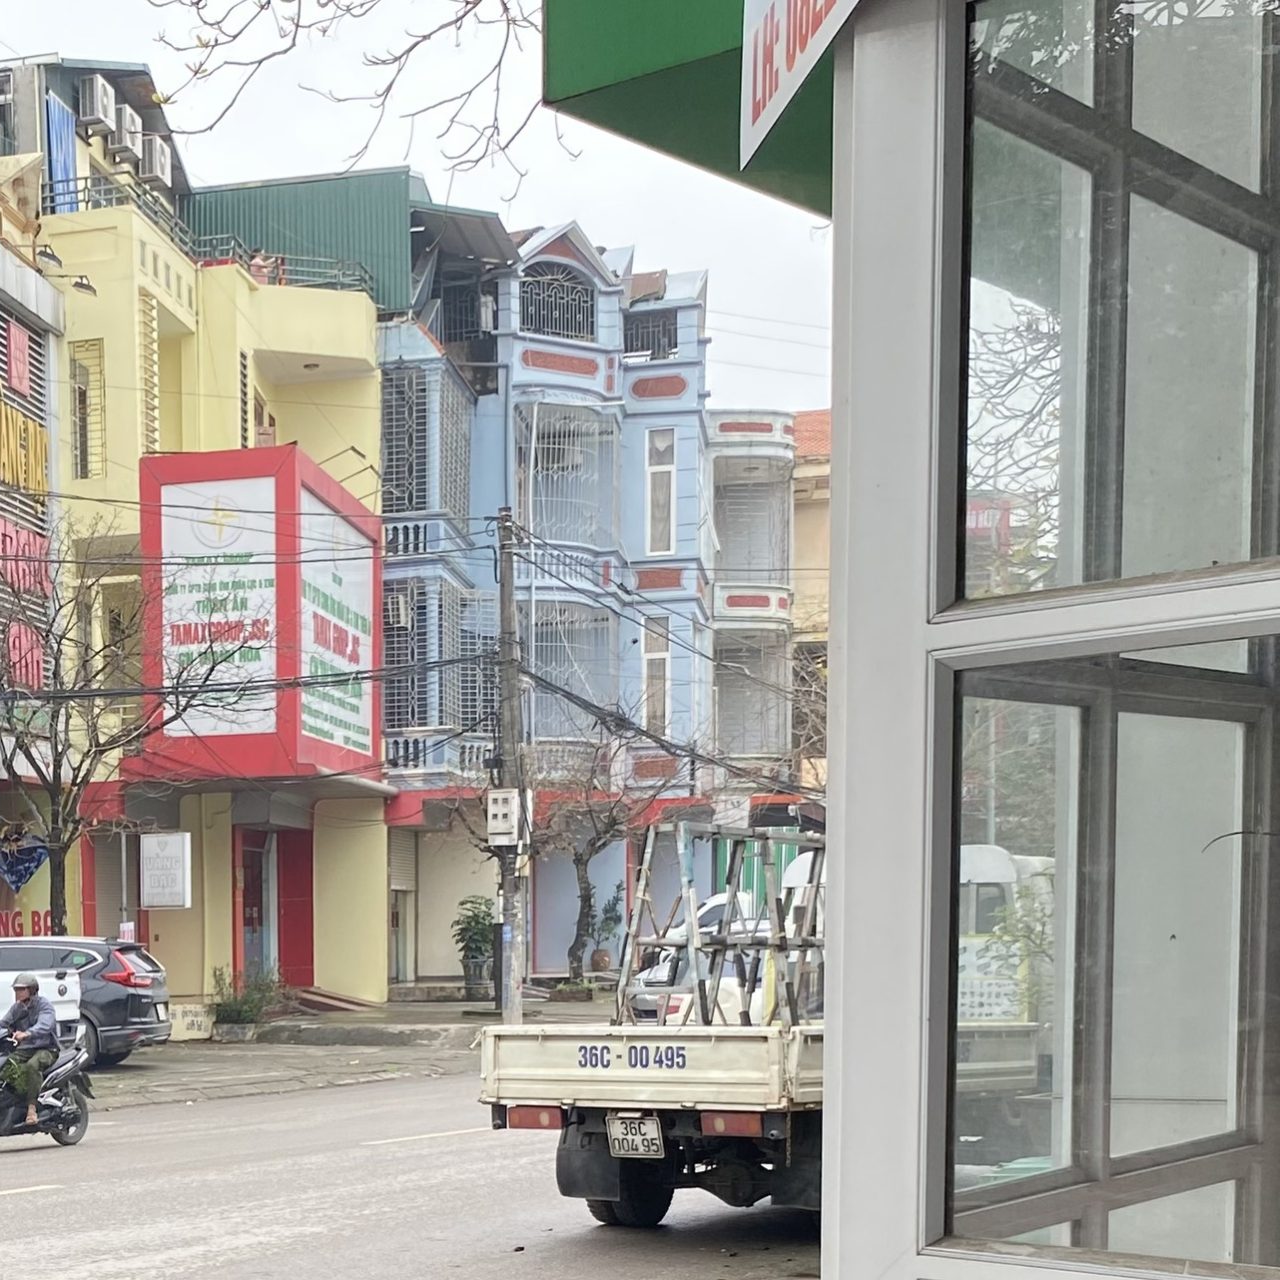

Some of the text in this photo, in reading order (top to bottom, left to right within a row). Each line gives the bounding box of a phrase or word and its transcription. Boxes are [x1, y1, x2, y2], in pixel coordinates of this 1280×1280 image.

[752, 2, 780, 126] LH:
[171, 622, 208, 646] TAMAX
[578, 1046, 611, 1068] 36C
[620, 1121, 647, 1136] 36C
